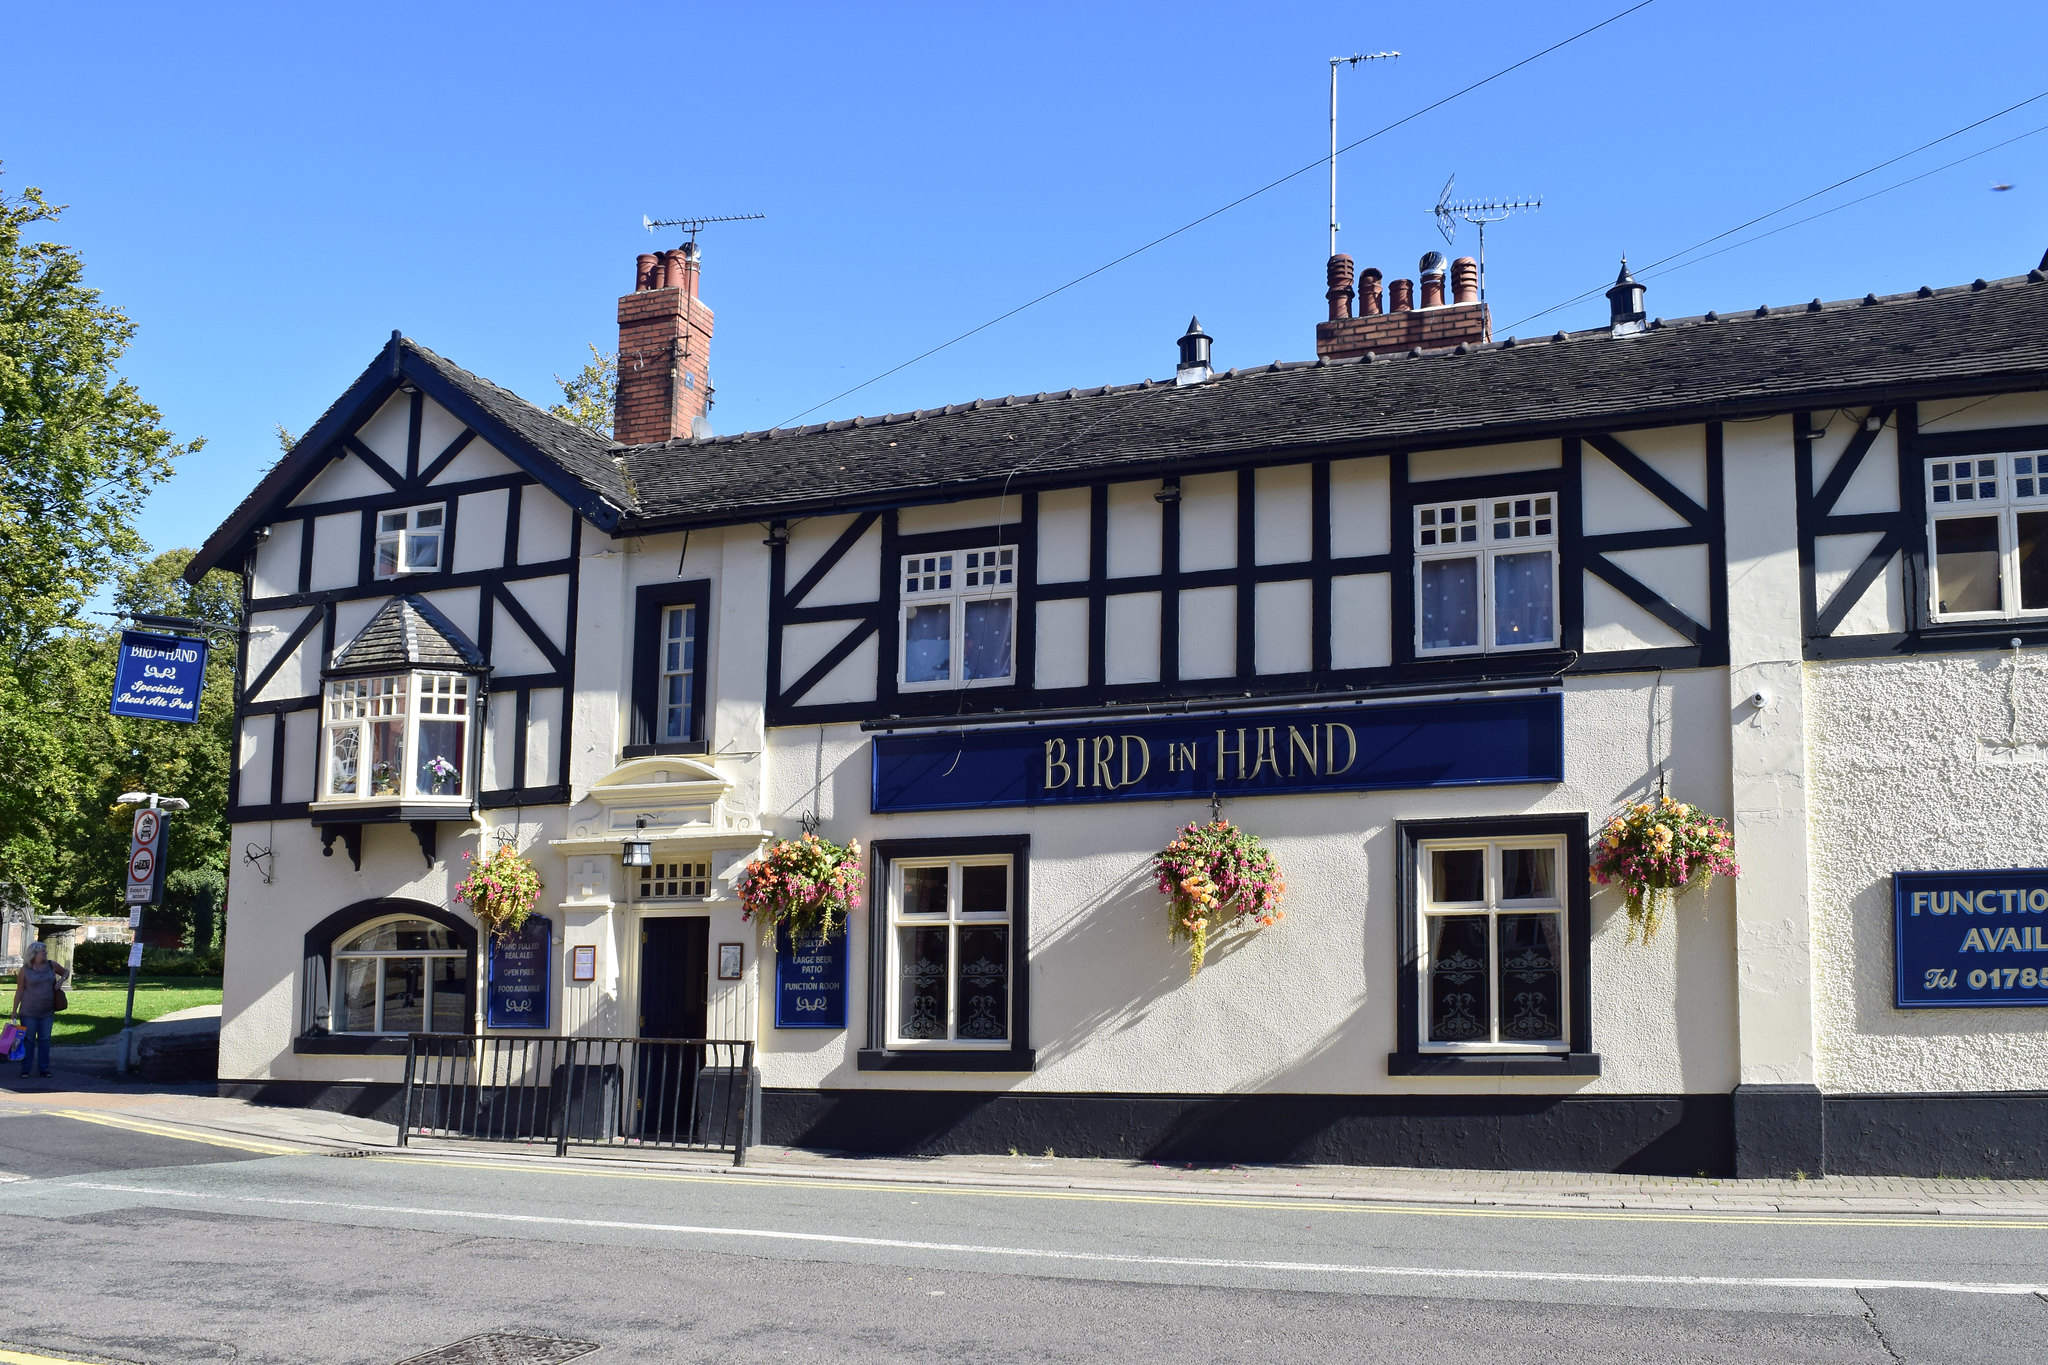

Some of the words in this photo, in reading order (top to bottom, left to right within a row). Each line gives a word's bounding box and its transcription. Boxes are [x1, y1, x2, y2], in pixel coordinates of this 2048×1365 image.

[130, 644, 157, 659] BIRD
[165, 648, 198, 663] HAND
[131, 680, 184, 695] Specialist
[117, 692, 146, 705] Real
[146, 696, 167, 707] Ale
[169, 697, 193, 710] Pub
[1044, 735, 1150, 790] BIRD
[1169, 742, 1197, 772] IN
[1215, 722, 1357, 781] HAND
[1911, 889, 2048, 916] FUNCTIO
[1959, 927, 2048, 952] AVAIL
[505, 951, 519, 960] REAL
[793, 956, 814, 965] LARGE
[815, 955, 833, 964] BEER
[503, 968, 519, 977] OPEN
[519, 968, 535, 976] FIRES
[802, 965, 823, 974] PATIO
[1923, 968, 1957, 989] Tel
[498, 985, 514, 993] FOOD
[514, 984, 540, 993] AVAILABLE
[785, 982, 818, 991] FUNCTION
[819, 982, 840, 990] ROOM
